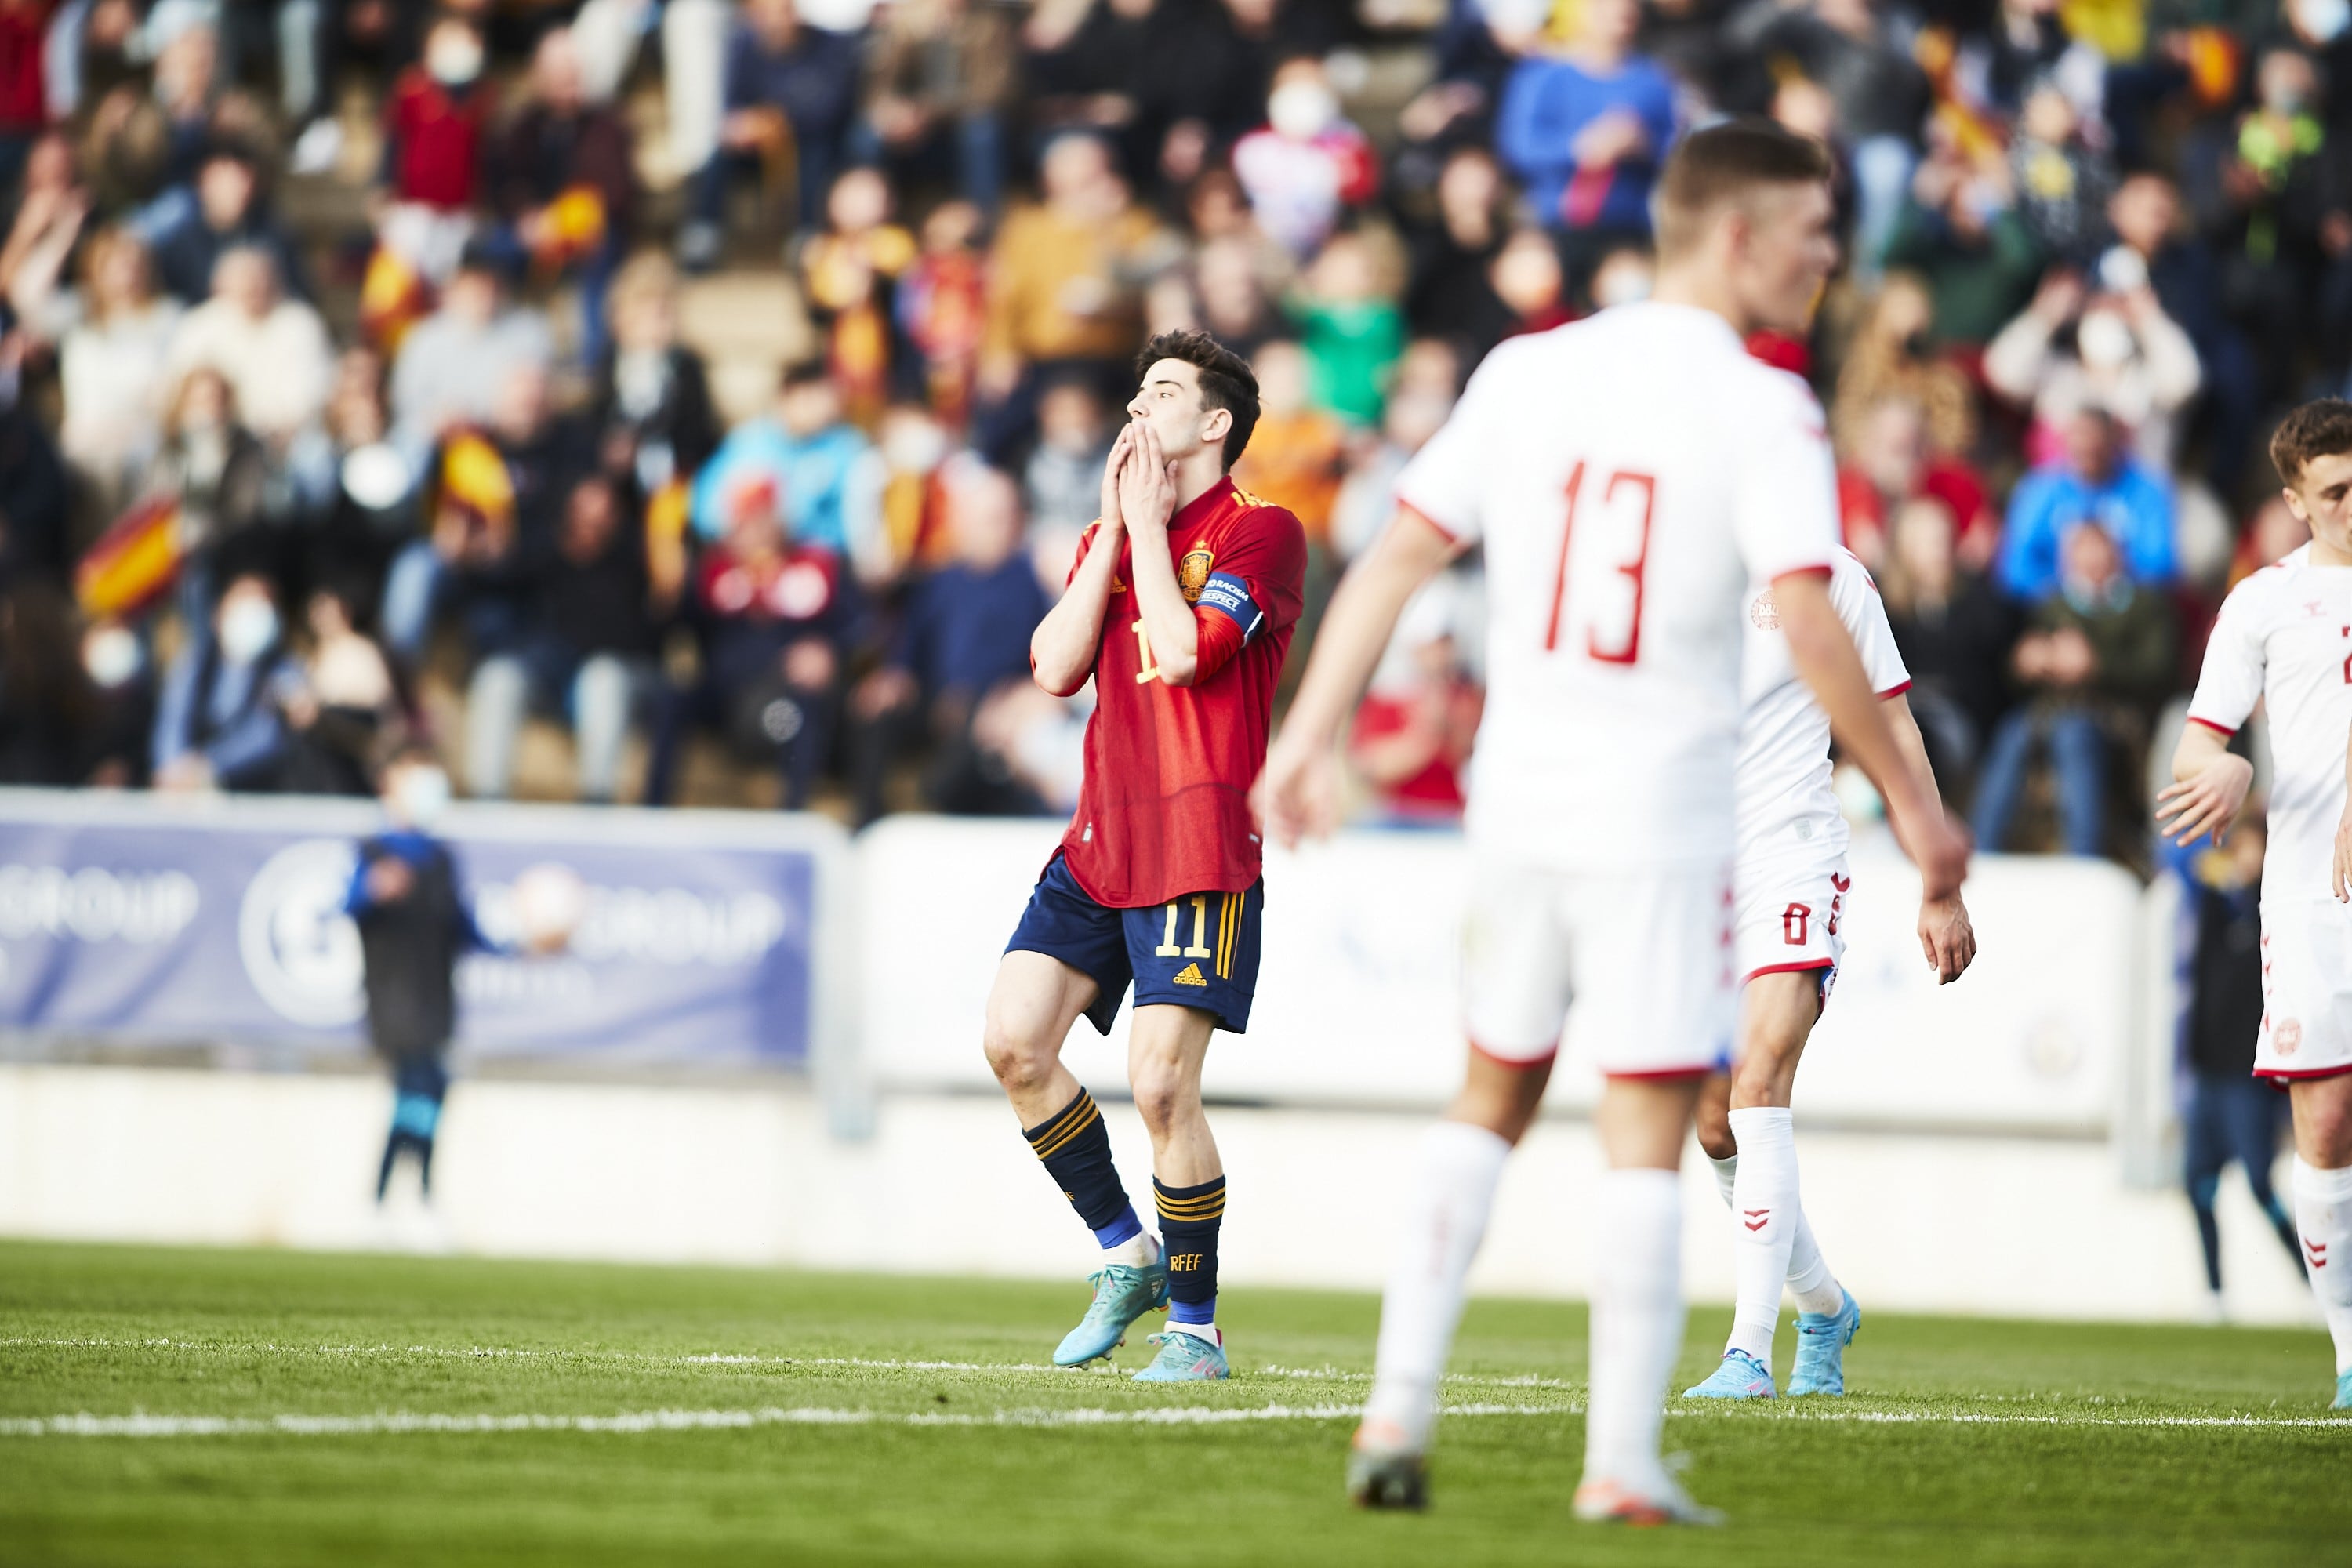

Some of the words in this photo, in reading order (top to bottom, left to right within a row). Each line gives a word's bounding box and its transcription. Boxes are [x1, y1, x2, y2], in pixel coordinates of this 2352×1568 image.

[1544, 459, 1655, 664] 13
[1201, 592, 1240, 608] RESPECT
[1216, 580, 1250, 601] RACISM
[1156, 895, 1211, 959] 11
[1173, 976, 1207, 987] adidas
[1170, 1254, 1203, 1272] RFEF
